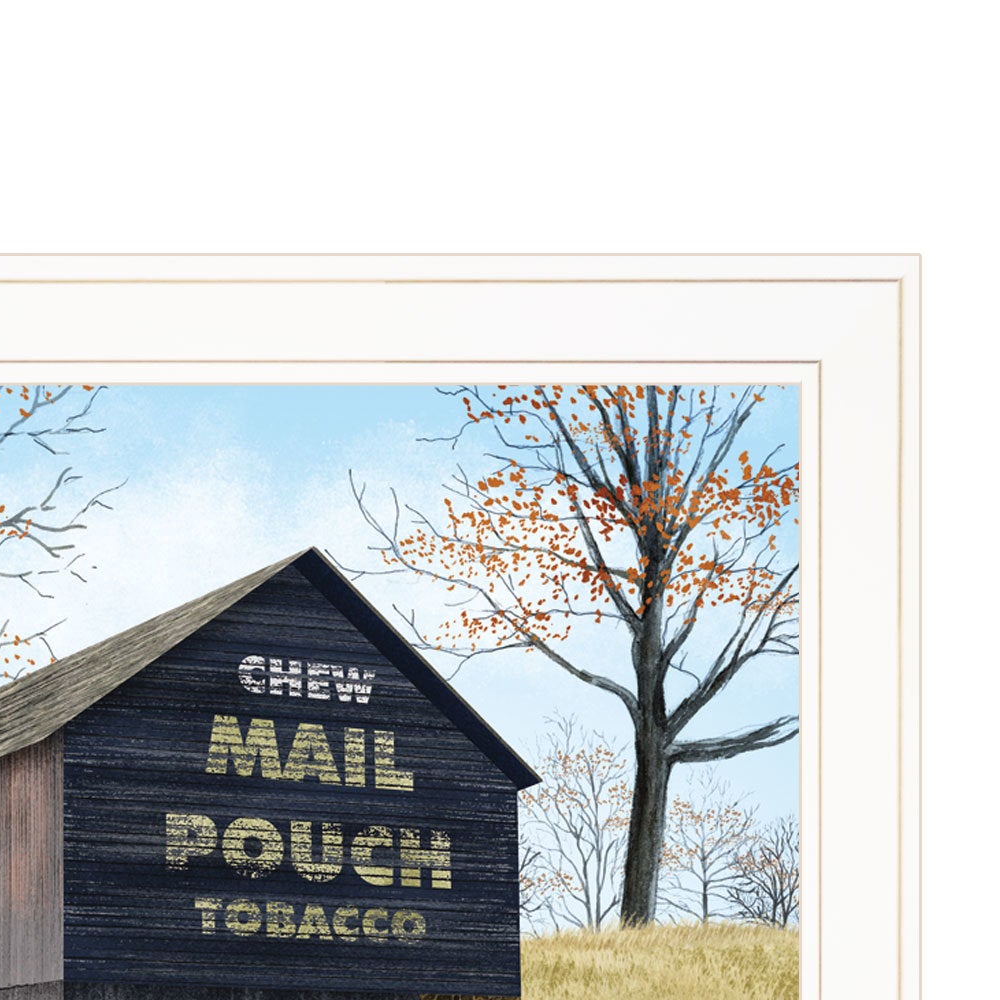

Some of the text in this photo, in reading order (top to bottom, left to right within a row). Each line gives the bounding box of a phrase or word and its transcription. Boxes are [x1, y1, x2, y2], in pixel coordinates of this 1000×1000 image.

[238, 655, 377, 704] CHEW
[205, 714, 414, 791] MAIL
[165, 813, 452, 889] POUCH
[194, 897, 427, 944] TOBACCO
